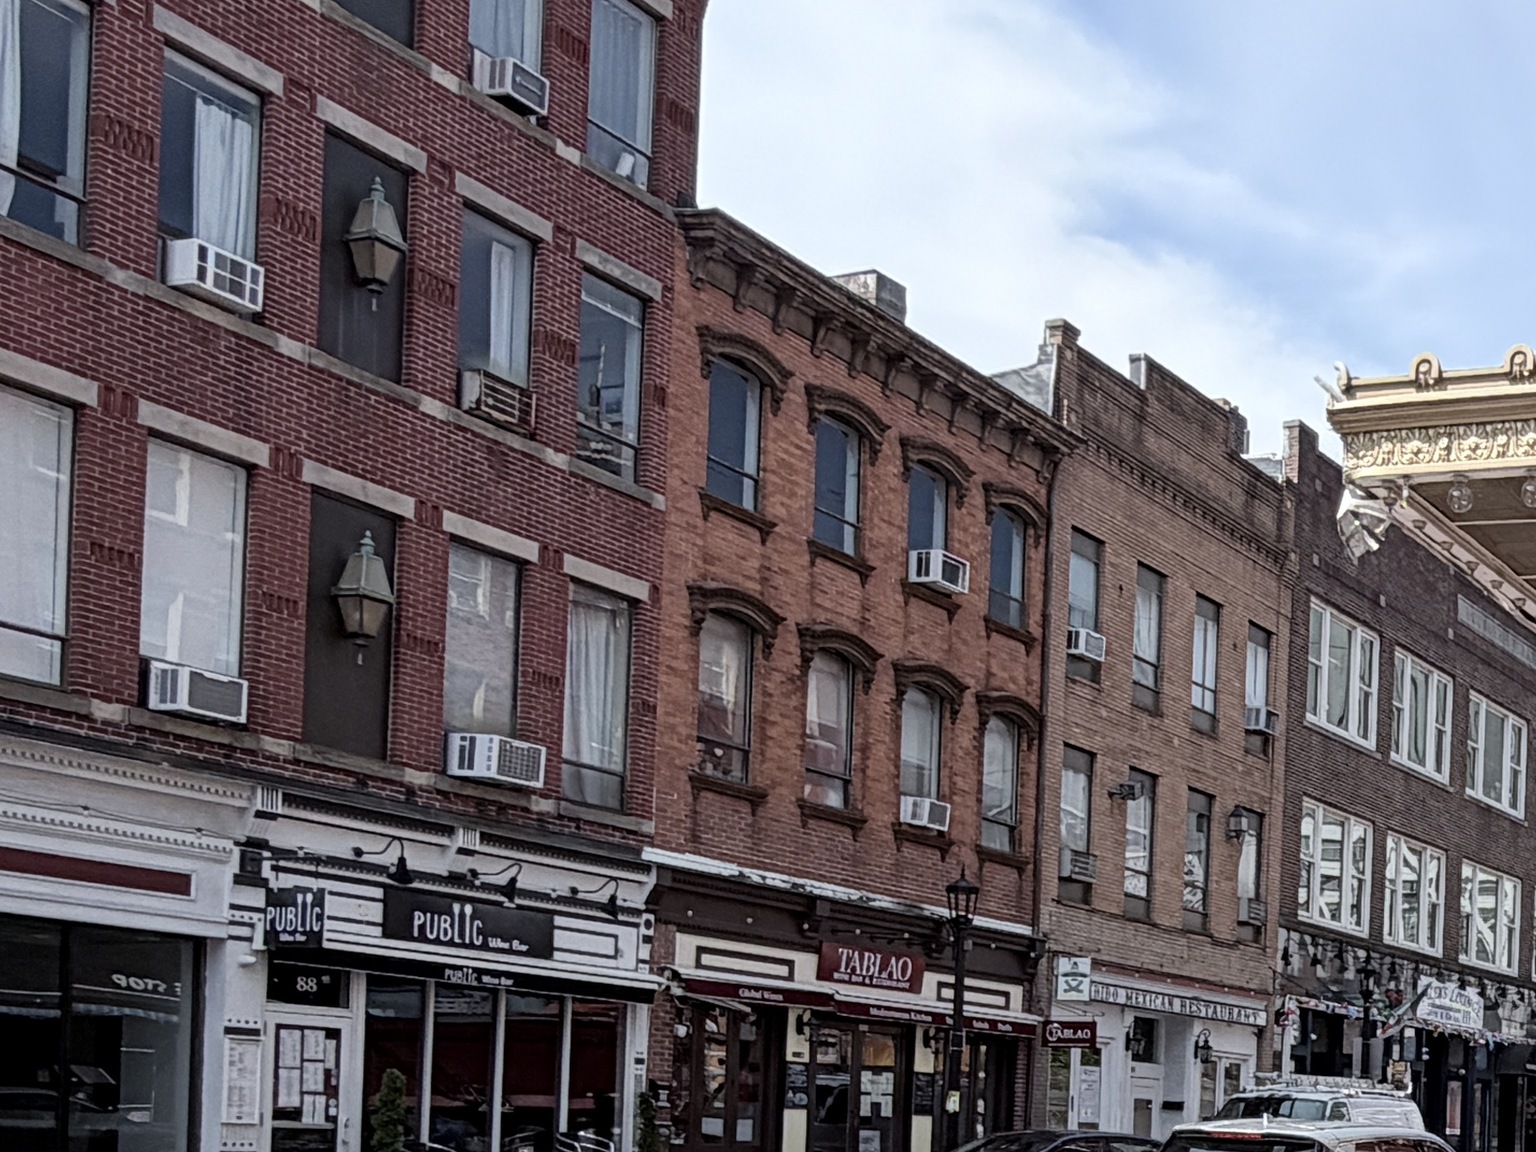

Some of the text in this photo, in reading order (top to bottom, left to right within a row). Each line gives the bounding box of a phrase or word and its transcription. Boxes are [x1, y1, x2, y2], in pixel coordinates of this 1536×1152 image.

[266, 892, 322, 932] PUBLIC
[412, 902, 483, 946] PUBLIC
[838, 947, 913, 981] TABLAO
[296, 976, 318, 992] 88
[1125, 990, 1174, 1012] MEXICAN
[1180, 999, 1260, 1023] RESTAURANT
